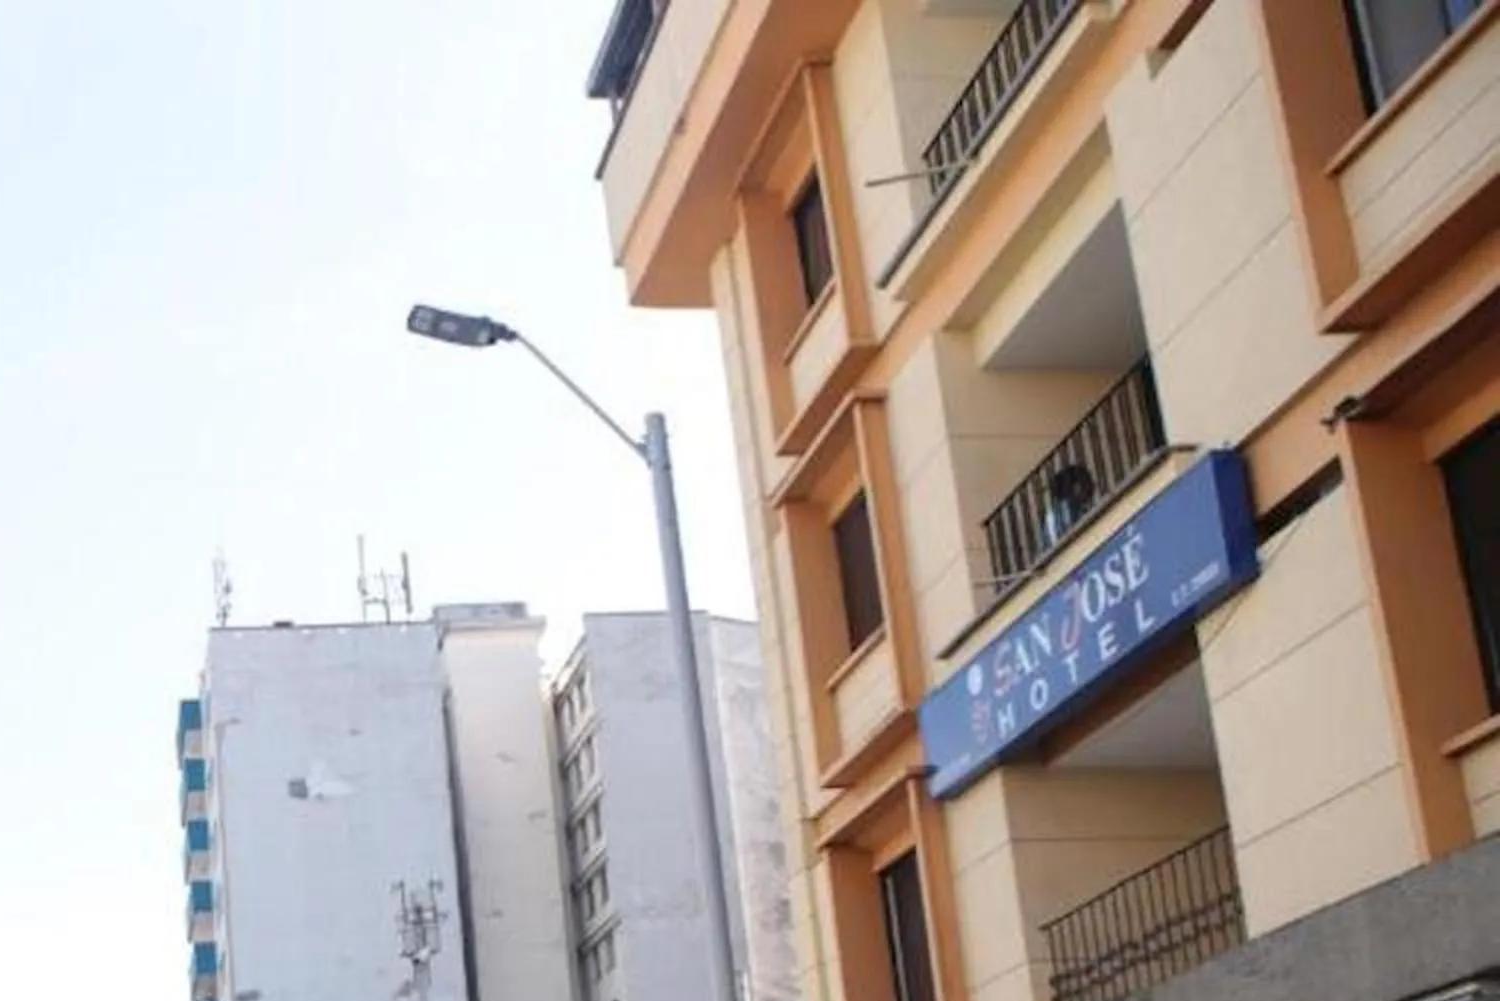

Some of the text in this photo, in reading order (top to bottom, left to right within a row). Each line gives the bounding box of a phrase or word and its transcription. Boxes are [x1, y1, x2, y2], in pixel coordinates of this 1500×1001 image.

[993, 612, 1054, 697] SAN
[1059, 523, 1151, 651] JOSÉ
[996, 599, 1156, 739] HOTEL
